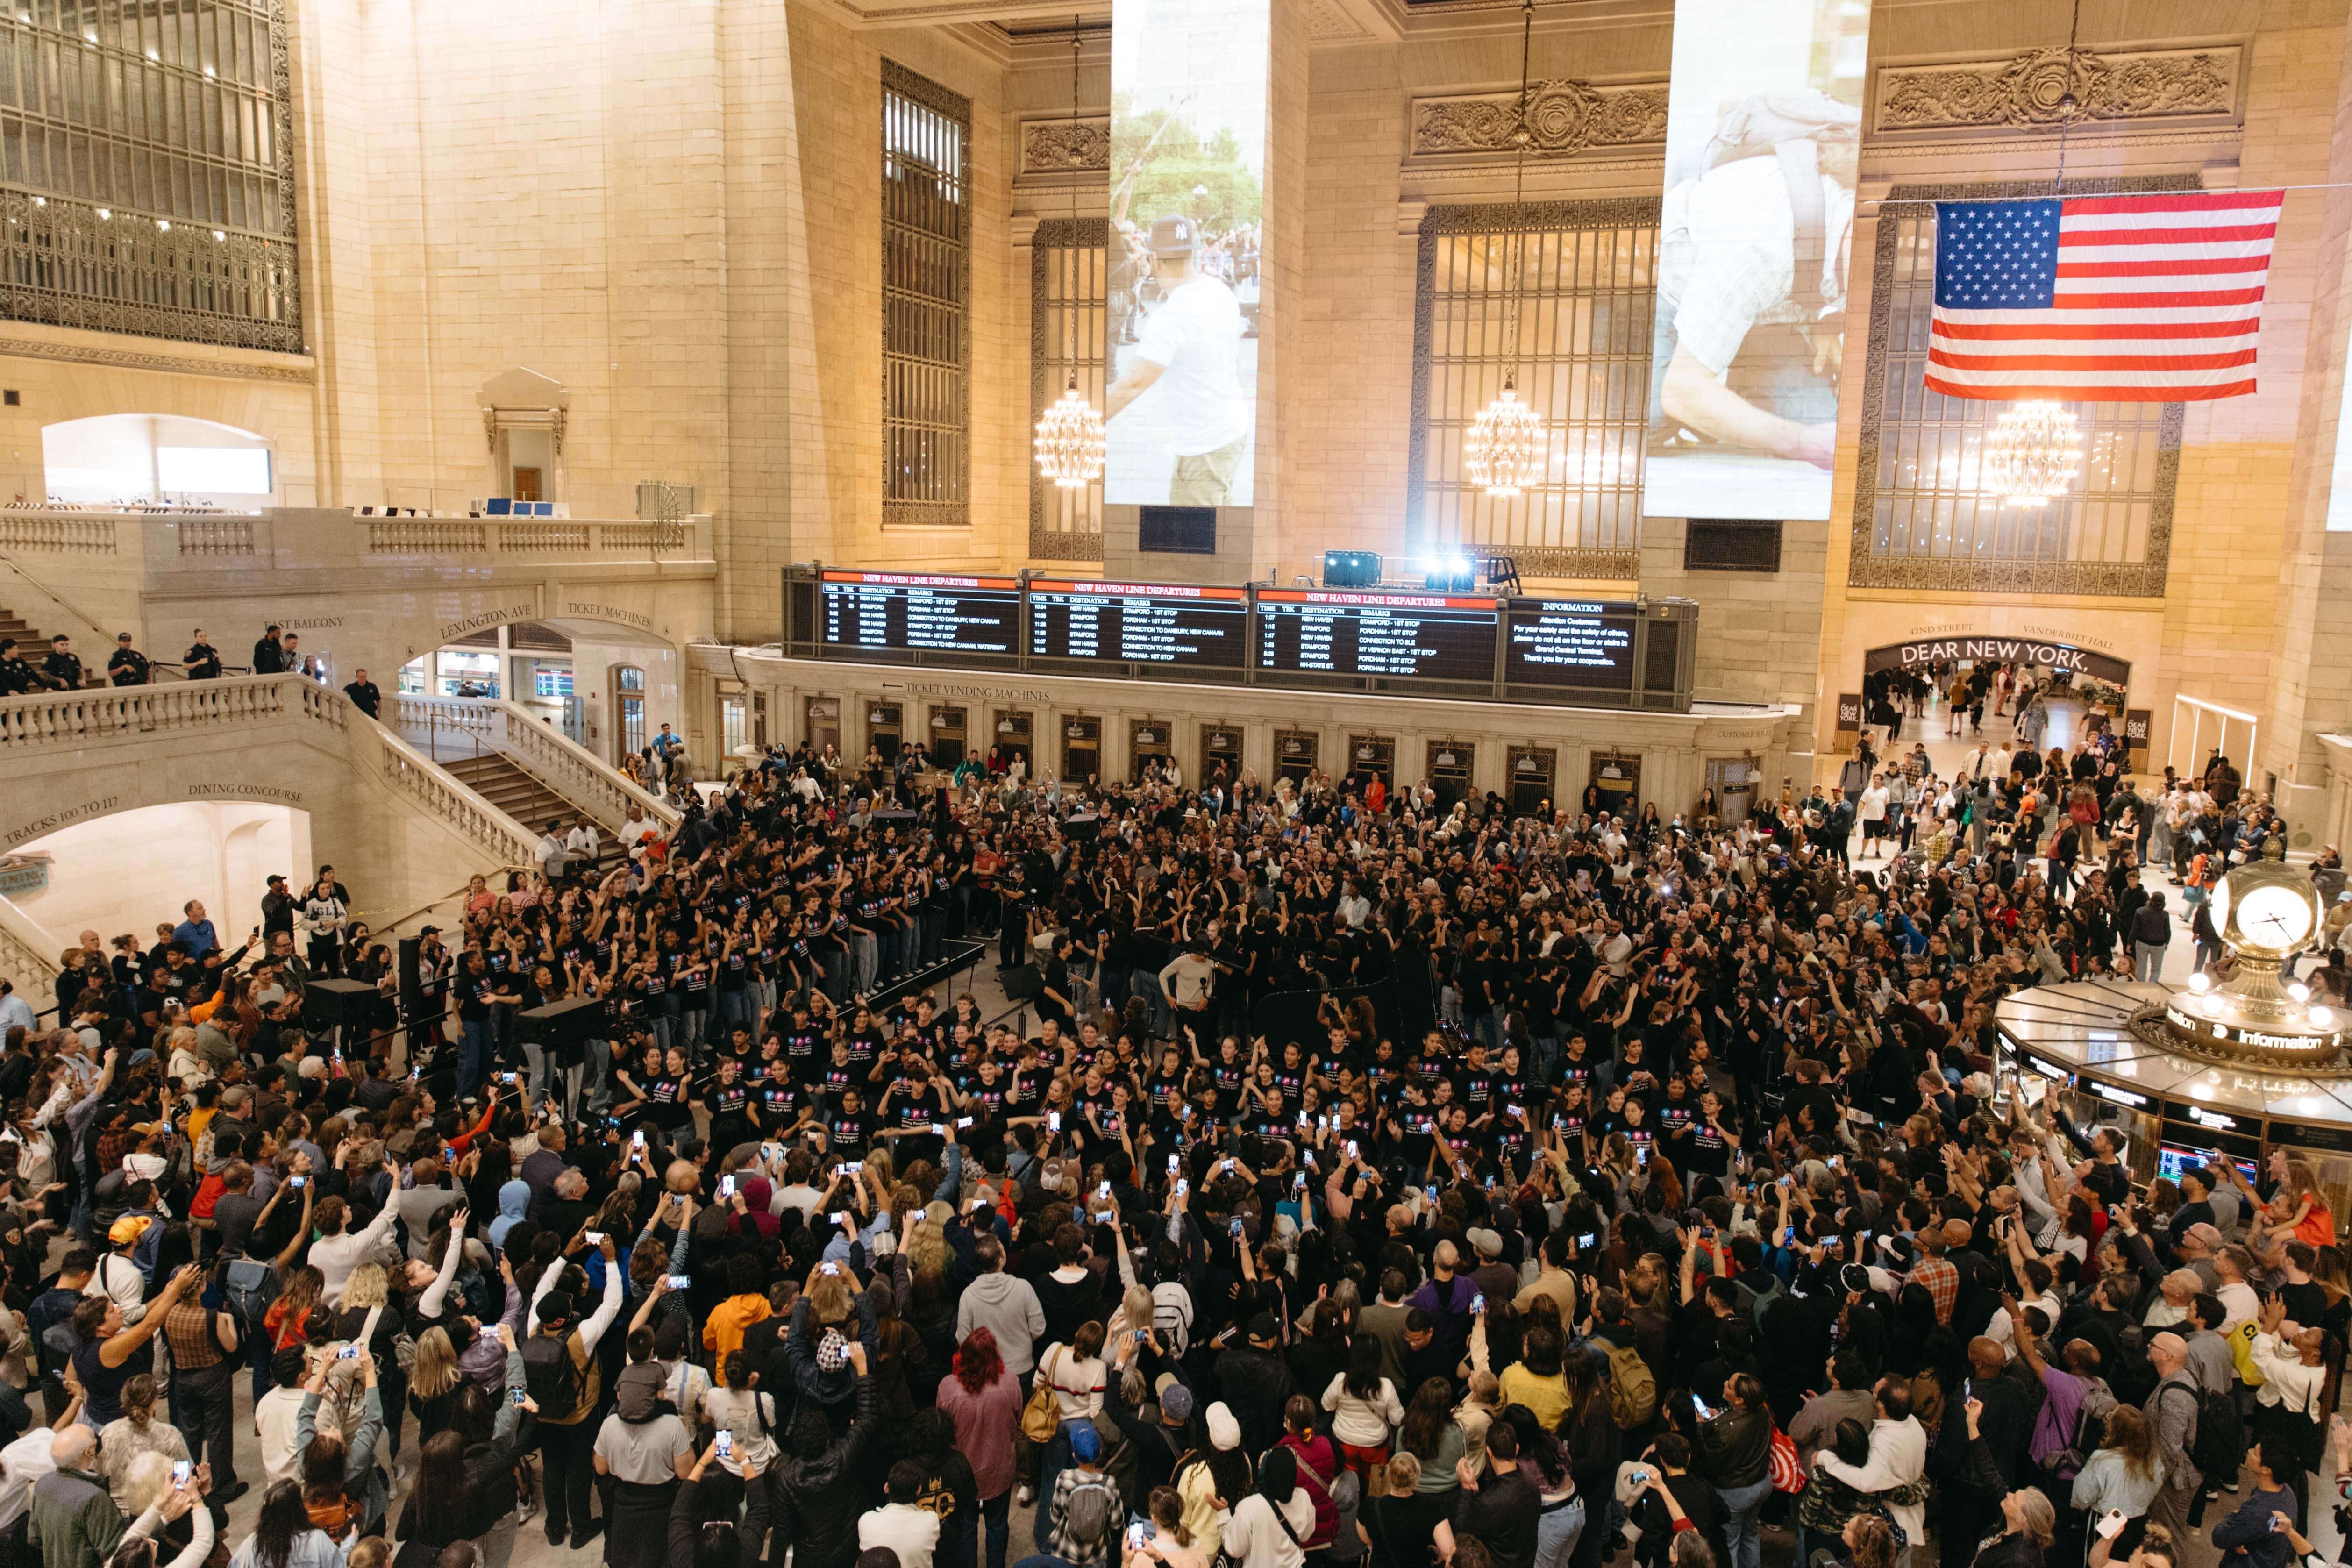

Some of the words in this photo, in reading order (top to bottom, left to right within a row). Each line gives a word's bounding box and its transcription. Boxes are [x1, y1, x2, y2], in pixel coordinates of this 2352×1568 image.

[929, 577, 978, 586] DEPARTURES
[1074, 583, 1093, 592] NEW
[1095, 584, 1124, 593] HAVEN
[1126, 585, 1145, 594] LINE
[1147, 586, 1200, 596] DEPARTURES
[1306, 593, 1327, 601] NEW
[1329, 594, 1361, 603] HAVEN
[1363, 595, 1385, 604] LINE
[1386, 596, 1445, 606] DEPARTURES
[1542, 602, 1603, 612] INFORMATION
[567, 603, 601, 615] TICKET
[604, 605, 651, 627] MACHINES
[264, 620, 292, 630] EAST
[294, 617, 343, 629] BALCONY
[440, 610, 509, 640] LEXINGTON
[511, 604, 531, 617] AVE
[2023, 626, 2087, 642] VANDERBILT
[2089, 637, 2114, 650] HALL
[1901, 642, 1959, 663] DEAR
[1967, 641, 2020, 658] NEW
[2026, 644, 2088, 672] YORK,
[905, 683, 941, 694] TICKET
[944, 685, 991, 697] VENDING
[995, 688, 1049, 701] MACHINES
[188, 784, 235, 795] DINING
[237, 784, 303, 802] CONCOURSE
[4, 815, 57, 844] TRACKS
[59, 808, 78, 822] 100
[81, 801, 100, 814] TO
[102, 796, 118, 810] 117
[2239, 1029, 2322, 1049] Information
[765, 1090, 794, 1101] YPC
[902, 1108, 930, 1119] YPC
[1661, 1109, 1690, 1118] YPC
[1259, 1125, 1288, 1134] YPC
